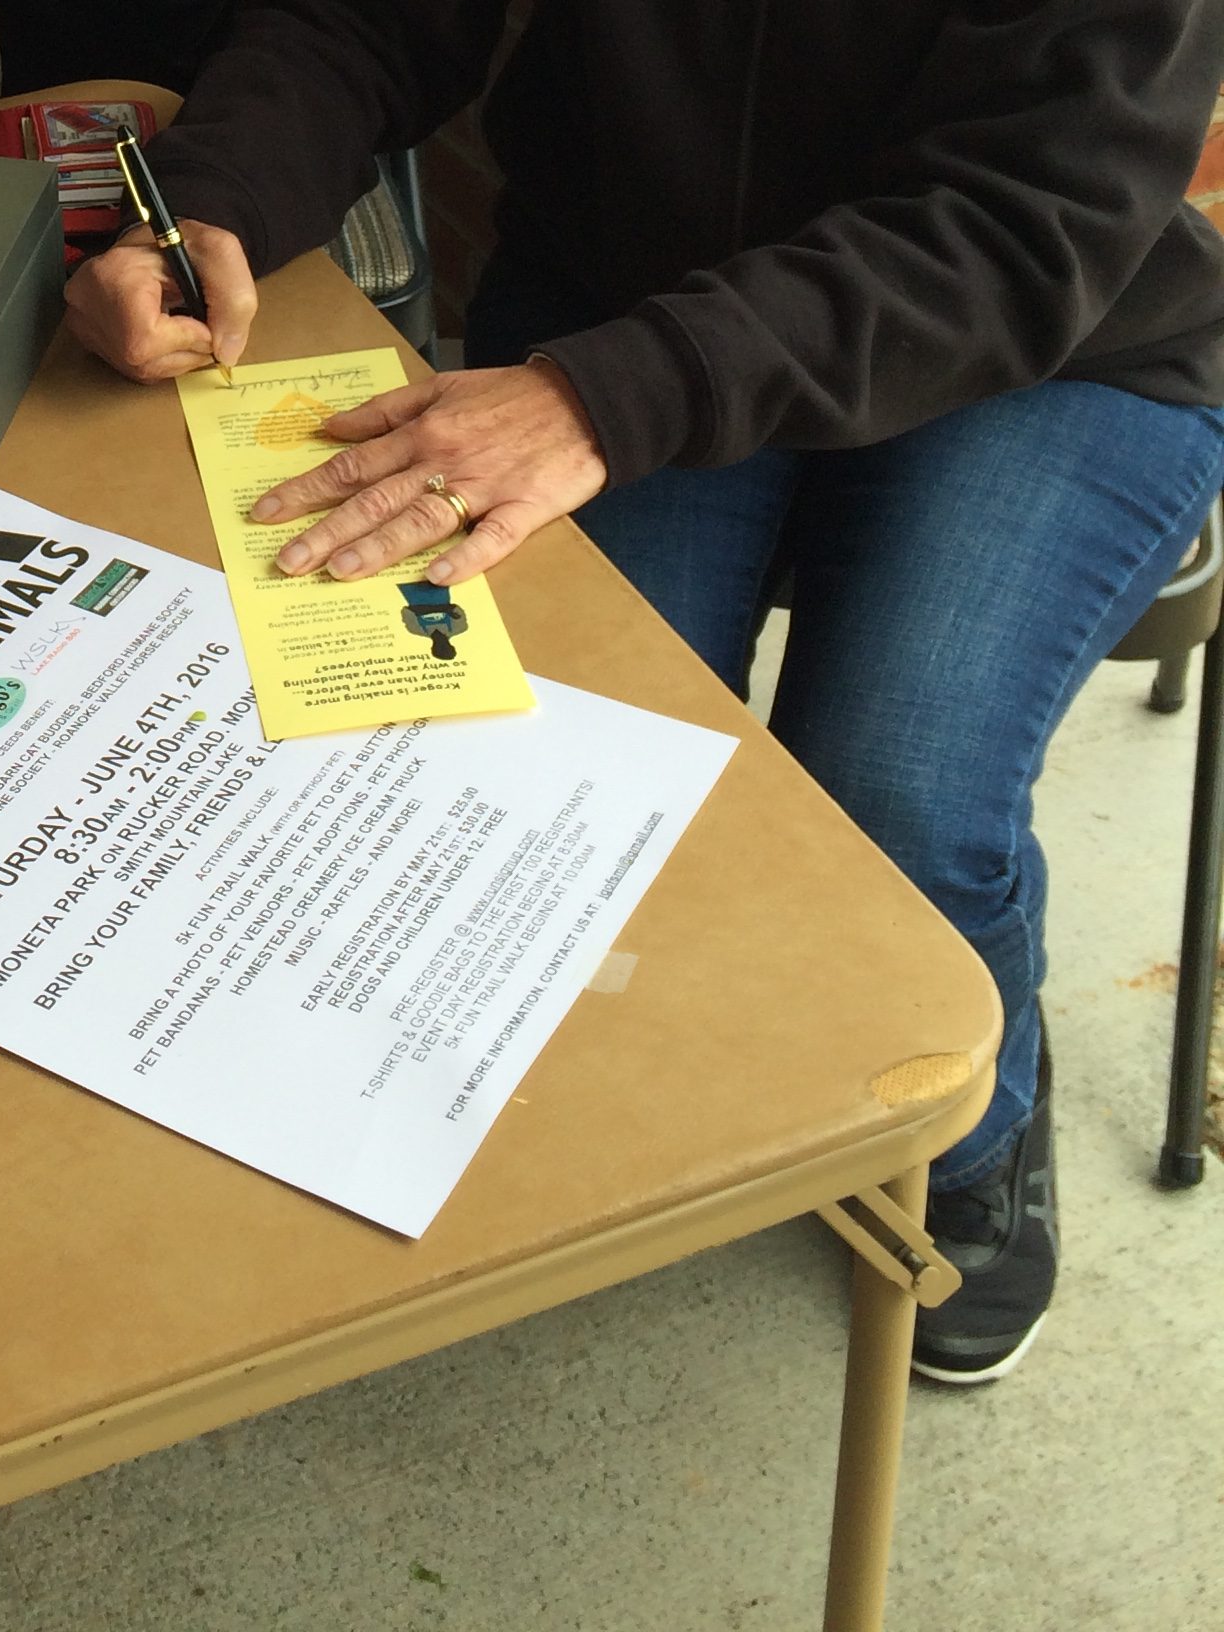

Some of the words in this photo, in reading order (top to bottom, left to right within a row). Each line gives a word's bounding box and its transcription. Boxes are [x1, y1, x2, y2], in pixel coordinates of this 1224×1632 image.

[9, 620, 70, 673] WSLK
[18, 742, 42, 762] CAT
[37, 703, 81, 743] BUDDIES
[80, 657, 125, 699] BEDFORD
[120, 622, 160, 657] HUMANE
[155, 587, 193, 622] SOCIETY
[282, 671, 360, 688] abandoning
[313, 656, 394, 673] employees?
[362, 666, 393, 677] they
[386, 675, 418, 685] than
[395, 664, 418, 672] are
[397, 653, 430, 663] their
[419, 669, 465, 680] money
[420, 659, 449, 670] why
[450, 656, 467, 666] so
[8, 752, 52, 793] SOCIETY
[52, 703, 100, 748] ROANOKE
[94, 670, 132, 703] VALLEY
[127, 640, 161, 671] HORSE
[155, 607, 193, 641] RESCUE
[19, 698, 56, 731] BENEFIT:
[78, 734, 144, 794] JUNE
[133, 690, 189, 734] 4TH,
[176, 641, 230, 687] 2016
[303, 696, 340, 706] more
[343, 688, 394, 702] making
[353, 680, 384, 688] ever
[396, 687, 408, 695] is
[411, 680, 460, 694] Kroger
[53, 796, 129, 864] 8:30AM
[128, 718, 199, 783] 2:00PM
[113, 840, 156, 881] SMITH
[149, 775, 213, 840] MOUNTAIN
[206, 742, 243, 775] LAKE
[53, 864, 105, 912] PARK
[100, 843, 125, 864] ON
[117, 775, 186, 841] RUCKER
[187, 903, 216, 929] FUN
[208, 869, 245, 902] TRAIL
[237, 834, 273, 868] WALK
[269, 812, 293, 835] (WITH
[287, 800, 303, 812] OR
[297, 766, 330, 800] WITHOUT
[325, 749, 345, 767] PET)
[194, 828, 242, 881] ACTIVITIES
[237, 786, 279, 829] INCLUDE:
[33, 951, 94, 1010] BRING
[85, 899, 140, 949] YOUR
[130, 837, 195, 899] FAMILY,
[185, 768, 253, 836] FRIENDS
[244, 754, 266, 767] &
[128, 998, 169, 1039] BRING
[172, 942, 214, 986] PHOTO
[208, 923, 229, 942] OF
[223, 888, 259, 922] YOUR
[251, 833, 304, 888] FAVORITE
[297, 810, 322, 833] PET
[315, 794, 336, 810] TO
[329, 770, 354, 794] GET
[354, 720, 397, 762] BUTTON
[230, 919, 297, 995] HOMESTEAD
[291, 854, 347, 918] CREAMERY
[341, 834, 365, 854] ICE
[358, 793, 396, 833] CREAM
[389, 756, 426, 793] TRUCK
[300, 969, 338, 1011] EARLY
[331, 888, 400, 970] REGISTRATION
[393, 871, 413, 888] BY
[406, 847, 431, 871] MAY
[447, 786, 479, 818] $25.00
[327, 922, 398, 1007] REGISTRATION
[391, 885, 427, 923] AFTER
[419, 860, 444, 885] MAY
[457, 801, 489, 834] $30.00
[347, 975, 382, 1013] DOGS
[375, 950, 401, 976] AND
[395, 892, 444, 950] CHILDREN
[437, 853, 474, 892] UNDER
[466, 837, 486, 852] 12:
[478, 807, 507, 836] FREE
[389, 936, 460, 1022] PRE-REGISTER
[465, 829, 540, 924] www.runsignup.com
[445, 1093, 471, 1121] FOR
[462, 1057, 494, 1092] MORE
[487, 984, 547, 1058] INFORMATION,
[539, 933, 579, 983] CONTACT
[572, 917, 591, 933] US
[583, 902, 601, 918] AT:
